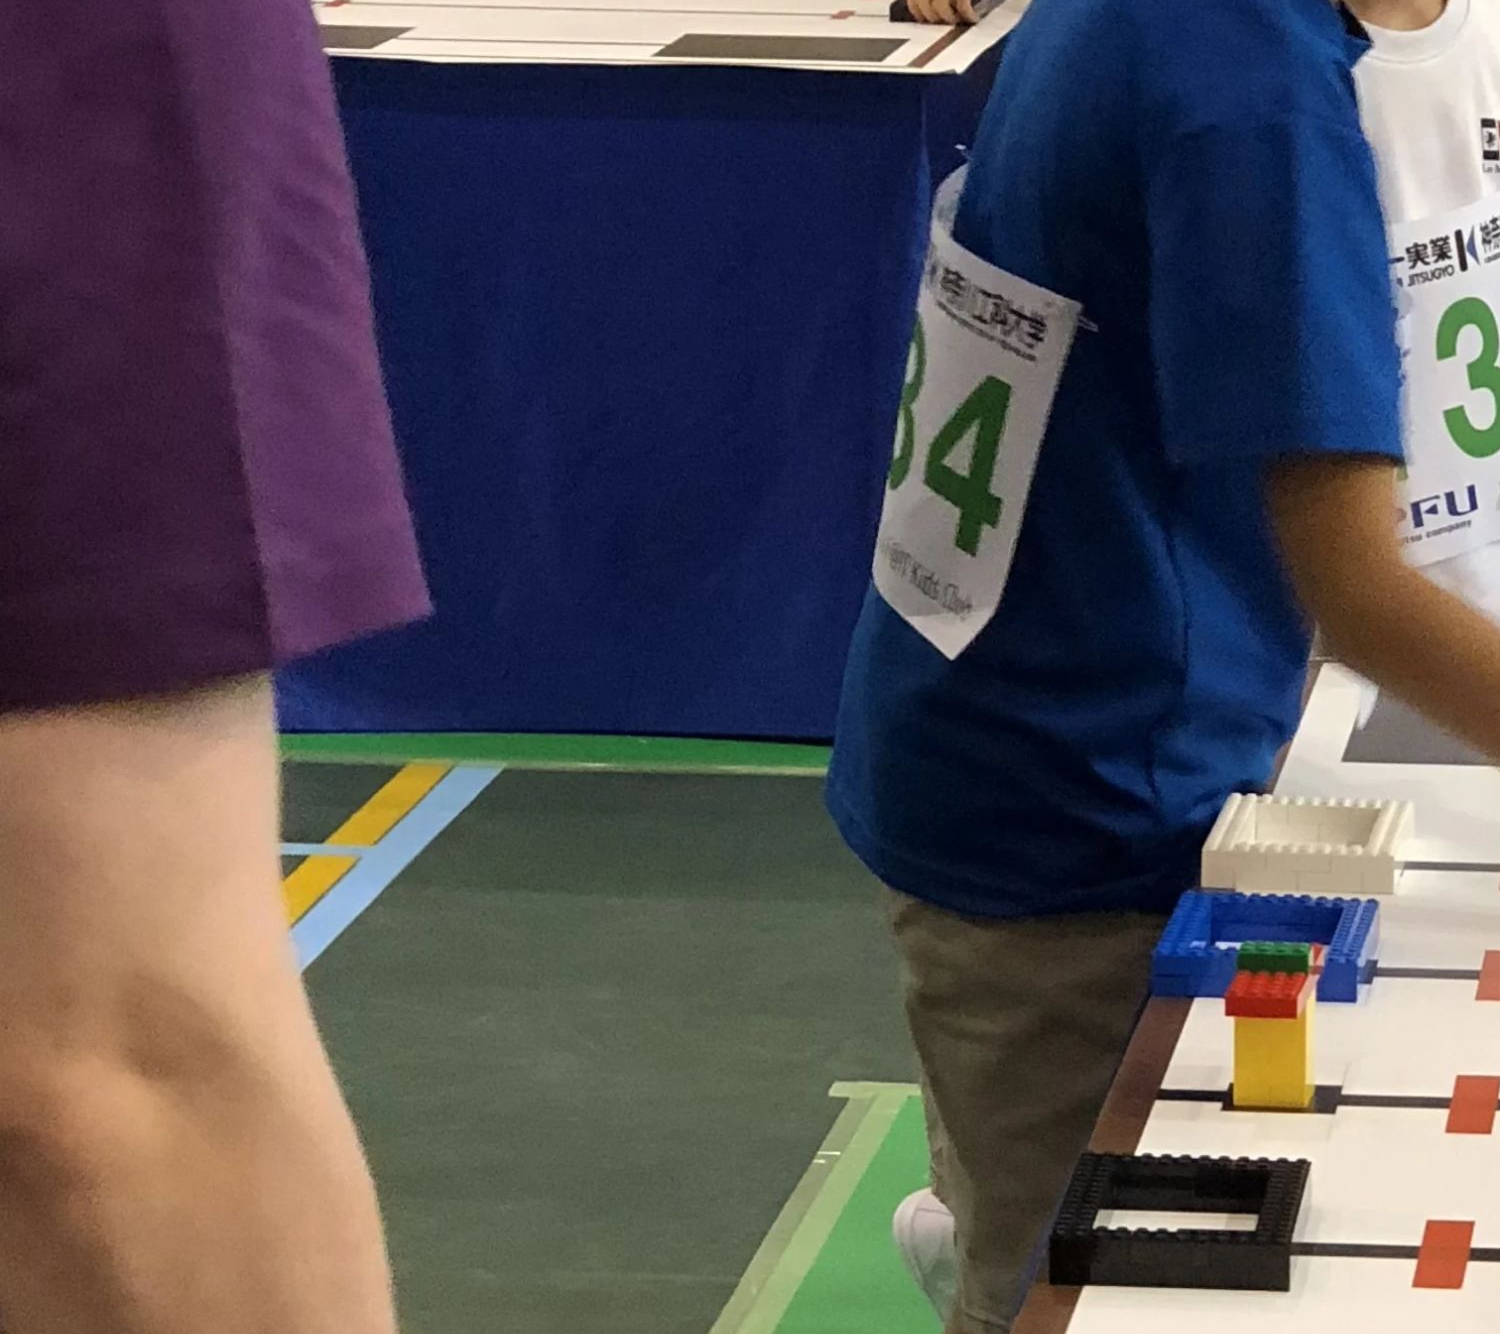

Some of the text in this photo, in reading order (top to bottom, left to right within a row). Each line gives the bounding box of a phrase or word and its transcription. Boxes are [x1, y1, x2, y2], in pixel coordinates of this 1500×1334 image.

[1389, 234, 1454, 269] 一実業
[1407, 264, 1455, 287] JITSUGYO
[1405, 483, 1479, 529] FU
